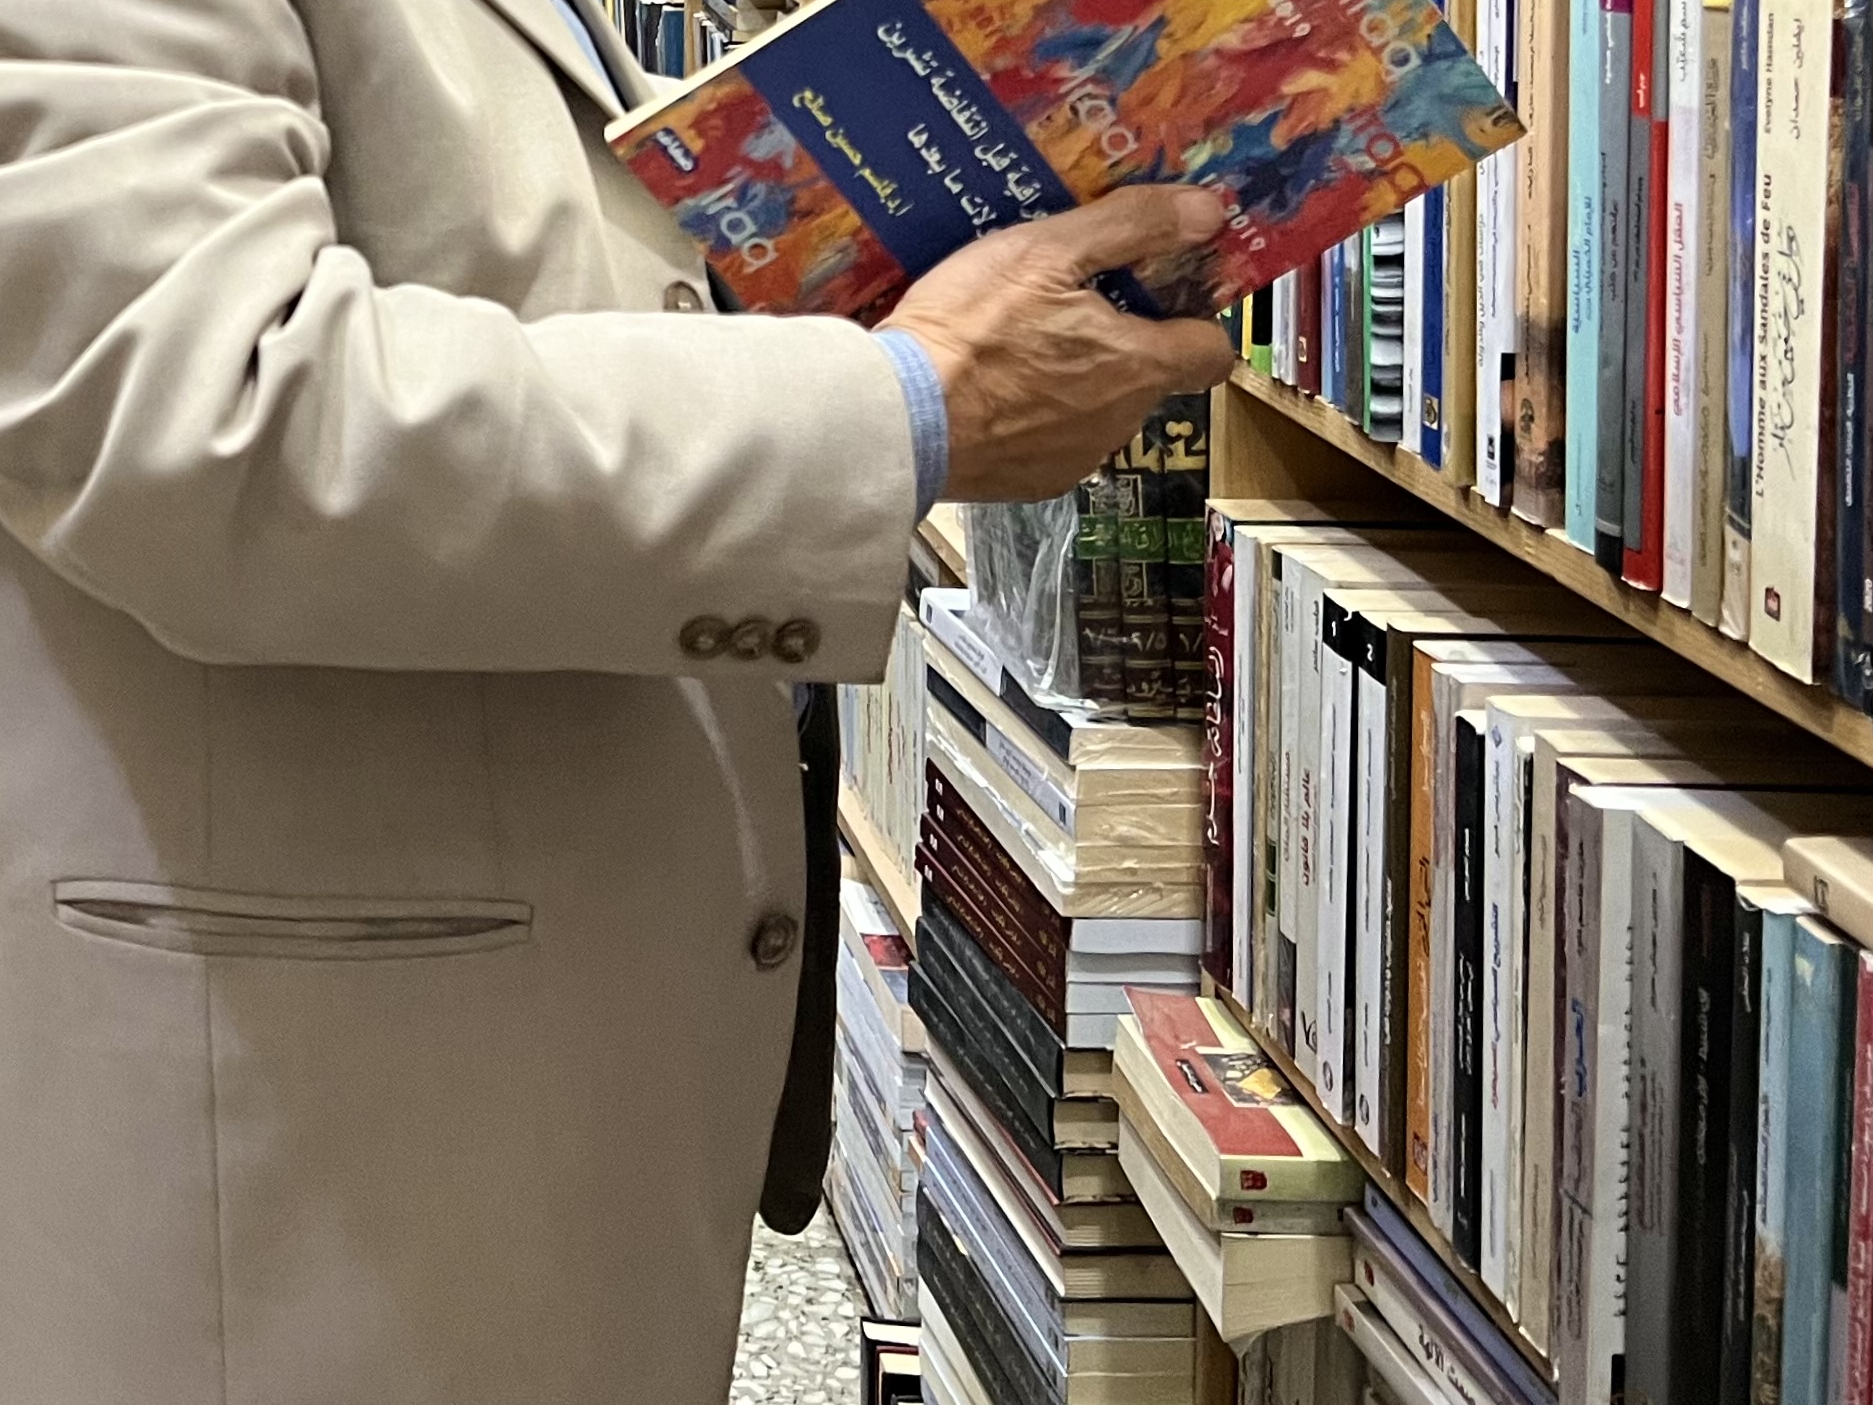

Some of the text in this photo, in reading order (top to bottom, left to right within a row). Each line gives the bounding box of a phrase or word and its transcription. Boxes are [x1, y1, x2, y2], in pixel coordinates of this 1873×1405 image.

[876, 19, 933, 80] تشرين
[930, 70, 989, 140] انتفاضة
[1762, 173, 1773, 213] Feu
[1760, 218, 1771, 245] de
[1757, 252, 1770, 347] Sandales
[1758, 353, 1767, 392] aux
[1362, 640, 1374, 660] 2
